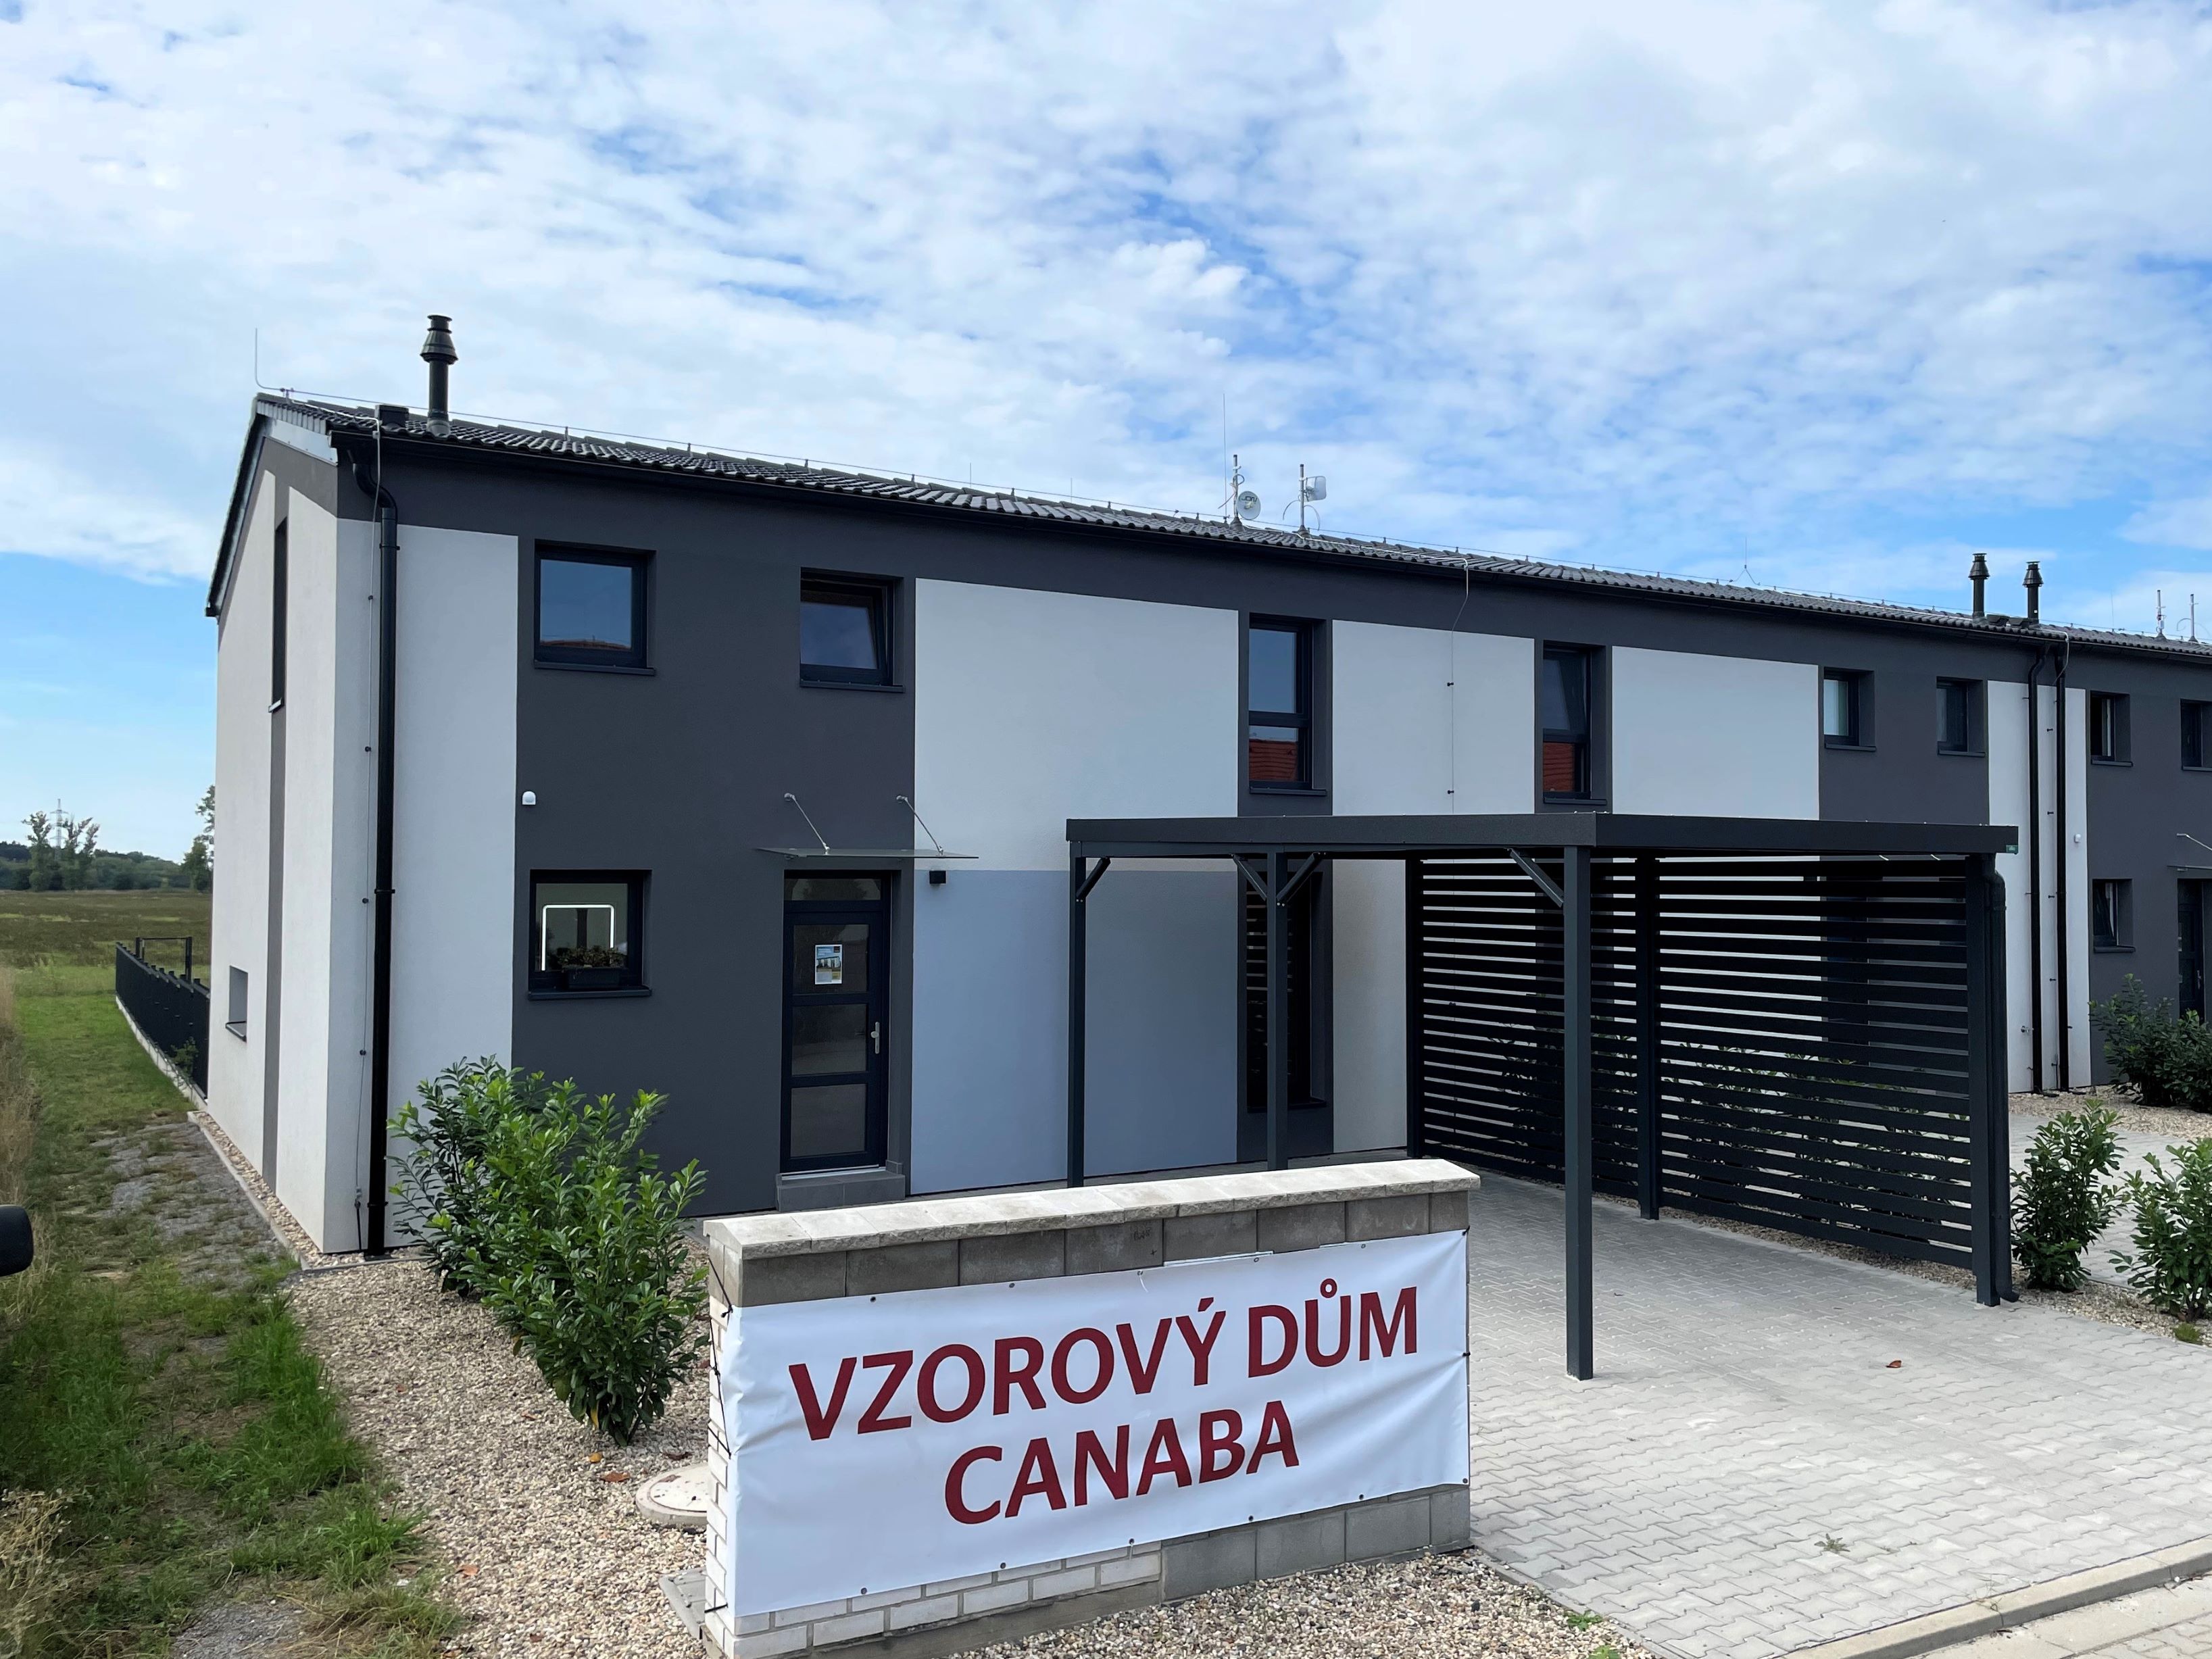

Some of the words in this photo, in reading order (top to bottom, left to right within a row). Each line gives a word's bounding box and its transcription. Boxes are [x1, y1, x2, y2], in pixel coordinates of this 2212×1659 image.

[789, 1297, 1226, 1440] VZOROVÝ
[1248, 1278, 1417, 1378] DŮM
[945, 1400, 1300, 1524] CANABA
